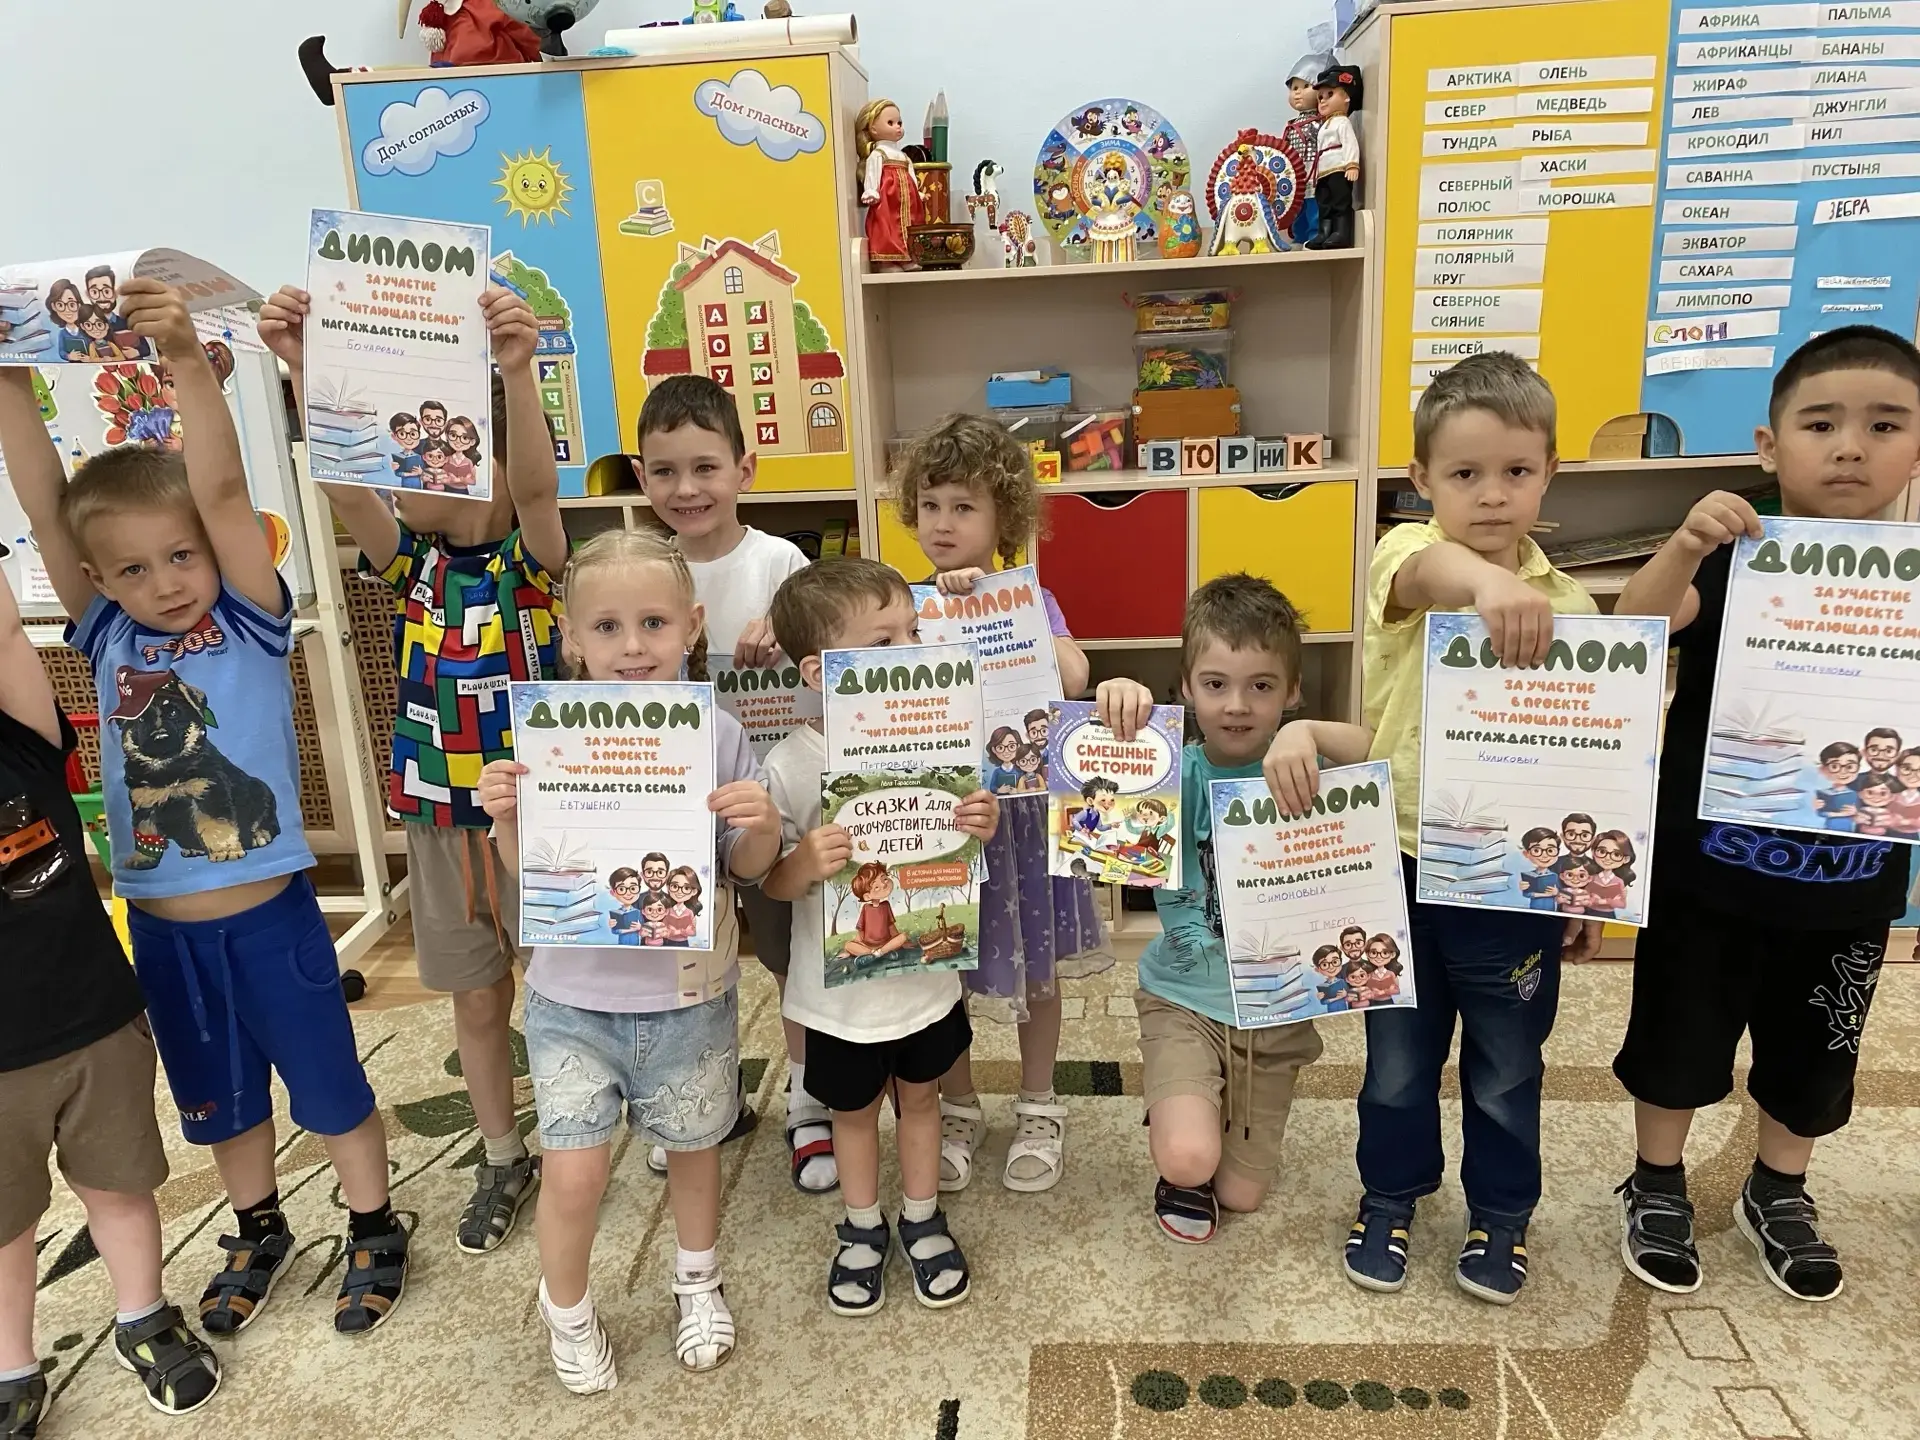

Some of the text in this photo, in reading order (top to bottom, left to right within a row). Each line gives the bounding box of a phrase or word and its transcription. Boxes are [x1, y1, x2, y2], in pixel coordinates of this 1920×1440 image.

[1827, 5, 1892, 21] ПАЛЬМА
[1699, 14, 1760, 29] АФРИКА
[1696, 43, 1793, 60] АФРИКАНЦЫ
[1821, 41, 1885, 56] БАНАНЫ
[1447, 70, 1512, 87] АРКТИКА
[1538, 66, 1588, 81] ОЛЕНЬ
[1815, 70, 1867, 85] ЛИАНА
[1692, 77, 1748, 92] ЖИРАФ
[1444, 103, 1486, 118] СЕВЕР
[1536, 97, 1607, 113] МЕДВЕДЬ
[1691, 106, 1720, 120] ЛЕВ
[1813, 98, 1887, 118] ДЖУНГЛИ
[710, 92, 809, 139] Дом гласных
[377, 100, 479, 163] Дом согласных
[1532, 128, 1572, 143] РЫБА
[1810, 127, 1843, 141] НИЛ
[1442, 135, 1497, 151] ТУНДРА
[1687, 132, 1769, 150] КРОКОДИЛ
[1539, 158, 1587, 173] ХАСКИ
[1811, 162, 1881, 178] ПУСТЫНЯ
[1438, 175, 1513, 193] СЕВЕРНЫЙ
[1685, 169, 1754, 183] САВАННА
[1437, 199, 1491, 214] ПОЛЮС
[1538, 191, 1615, 207] МОРОШКА
[1682, 206, 1729, 219] ОКЕАН
[1829, 198, 1870, 220] ЗЕБРА
[1436, 226, 1514, 242] ПОЛЯРНИК
[1682, 236, 1746, 250] ЭКВАТОР
[318, 230, 475, 277] ДИПЛОМ
[1434, 249, 1514, 266] ПОЛЯРНЫЙ
[1679, 265, 1733, 278] САХАРА
[366, 274, 437, 292] ЗА УЧАСТИЕ
[1432, 273, 1466, 287] КРУГ
[381, 291, 433, 307] ПРОЕКТЕ
[1432, 295, 1500, 308] СЕВЕРНОЕ
[1676, 293, 1753, 308] ЛИМПОПО
[340, 300, 465, 326] "ЧИТАЮЩАЯ СЕМЬЯ"
[709, 308, 723, 323] А
[750, 305, 762, 320] Я
[1430, 315, 1485, 329] СИЯНИЕ
[321, 318, 459, 345] НАГРАЖДАЕТСЯ СЕМЬЯ
[1654, 321, 1728, 343] СЛОН
[712, 339, 726, 353] О
[753, 333, 765, 350] Ё
[1431, 340, 1483, 354] ЕНИСЕЙ
[715, 369, 728, 384] У
[752, 367, 771, 381] Ю
[759, 397, 771, 411] Е
[761, 427, 776, 441] И
[1747, 539, 1920, 582] ДИПЛО
[918, 583, 1034, 620] ДИПЛОМ
[1814, 586, 1912, 603] ЗА УЧАСТИЕ
[1833, 604, 1904, 621] ПРОЕКТЕ
[961, 618, 1014, 634] ЗА УЧАСТИЕ
[1775, 617, 1879, 637] "ЧИТАЮЩАЯ
[1746, 636, 1876, 658] НАГРАЖДАЕТСЯ
[1008, 655, 1037, 668] СЕМЬЯ
[834, 659, 974, 695] ДИПЛОМ
[1504, 679, 1596, 694] ЗА УЧАСТИЕ
[735, 695, 796, 707] ЗА УЧАСТИЕ
[884, 696, 950, 710] ЗА УЧАСТИЕ
[1524, 697, 1591, 711] ПРОЕКТЕ
[525, 701, 701, 730] ДИПЛОМ
[750, 707, 793, 717] ПРОЕКТЕ
[899, 709, 948, 723] ПРОЕКТЕ
[1470, 710, 1632, 731] "ЧИТАЮЩАЯ СЕМЬЯ"
[861, 720, 974, 738] "ЧИТАЮЩАЯ СЕМЬЯ"
[584, 736, 661, 747] ЗА УЧАСТИЕ
[843, 738, 971, 757] НАГРАЖДАЕТСЯ СЕМЬЯ
[1445, 729, 1622, 751] НАГРАЖДАЕТСЯ СЕМЬЯ
[602, 750, 658, 761] ПРОЕКТЕ
[1076, 744, 1158, 761] СМЕШНЫЕ
[558, 764, 692, 776] "ЧИТАЮЩАЯ СЕМЬЯ"
[1079, 759, 1154, 777] ИСТОРИИ
[538, 782, 686, 794] НАГРАЖДАЕТСЯ СЕМЬЯ
[854, 797, 919, 816] СКАЗКИ
[1276, 821, 1346, 841] ЗА УЧАСТИЕ
[877, 834, 924, 855] ДЕТЕЙ
[1293, 834, 1344, 852] ПРОЕКТЕ
[1253, 842, 1376, 871] "ЧИТАЮЩАЯ СЕМЬЯ"
[1237, 860, 1373, 889] НАГРАЖДАЕТСЯ СЕМЬЯ
